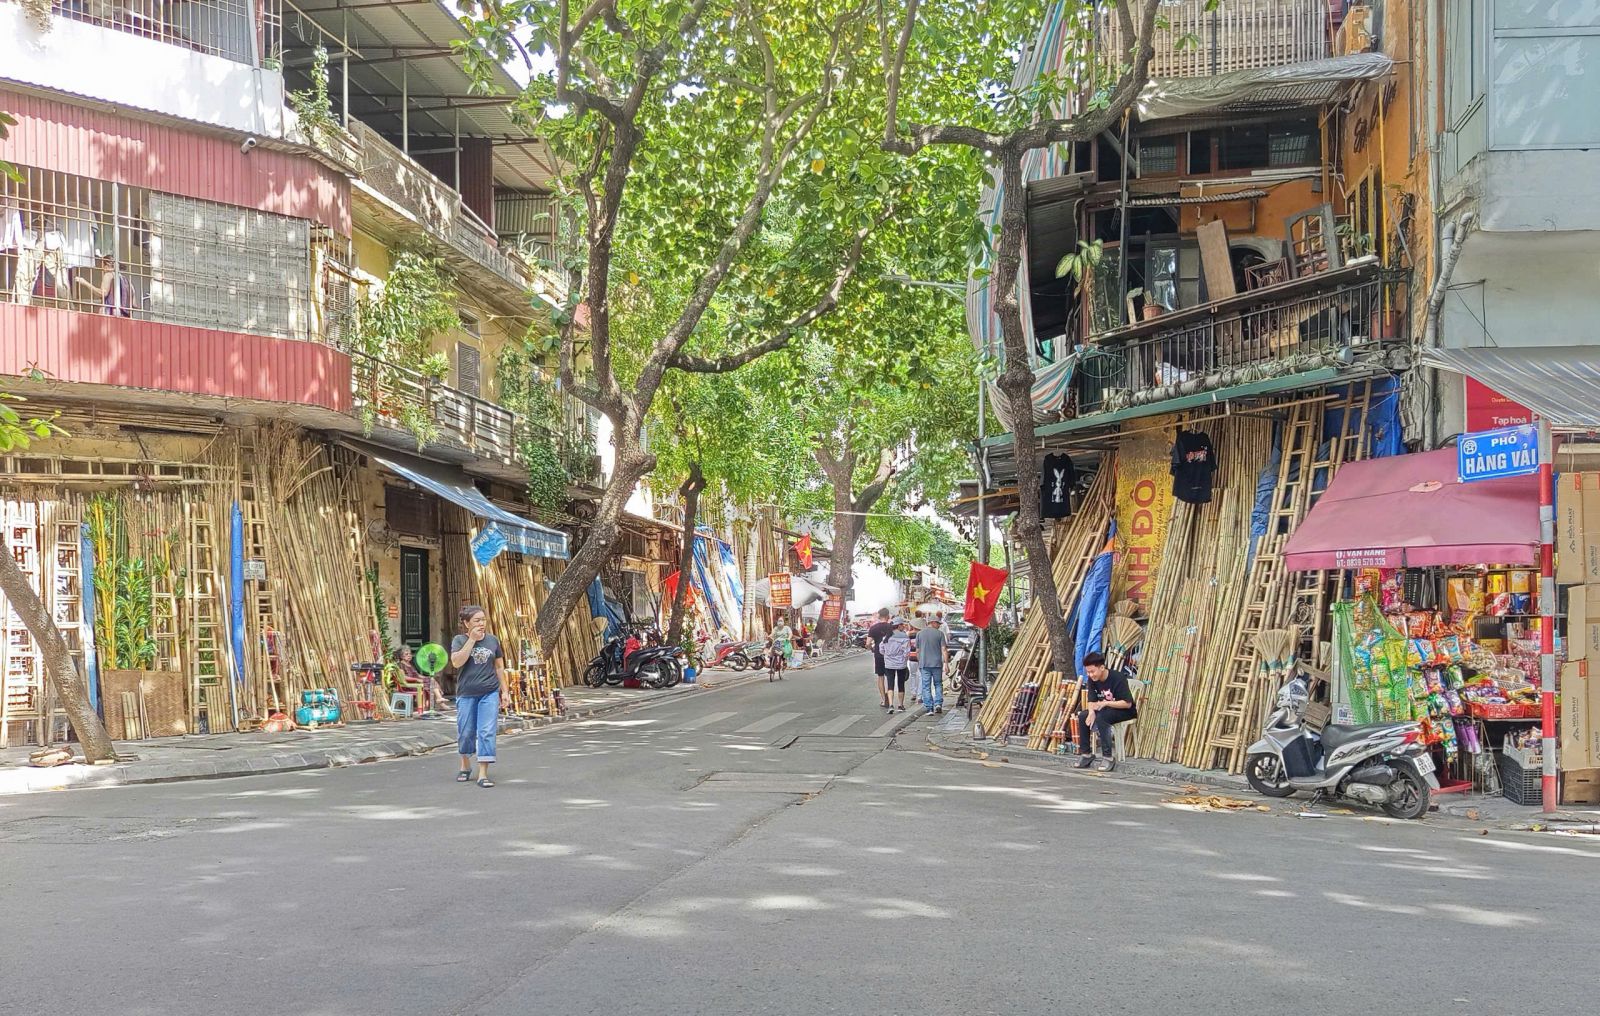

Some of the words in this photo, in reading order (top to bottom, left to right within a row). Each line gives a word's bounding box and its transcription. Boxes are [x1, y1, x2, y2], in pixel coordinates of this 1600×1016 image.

[1491, 431, 1518, 447] PHỐ
[1465, 452, 1507, 474] HÀNG
[1511, 443, 1536, 468] VẢI
[1130, 479, 1156, 537] ĐÔ
